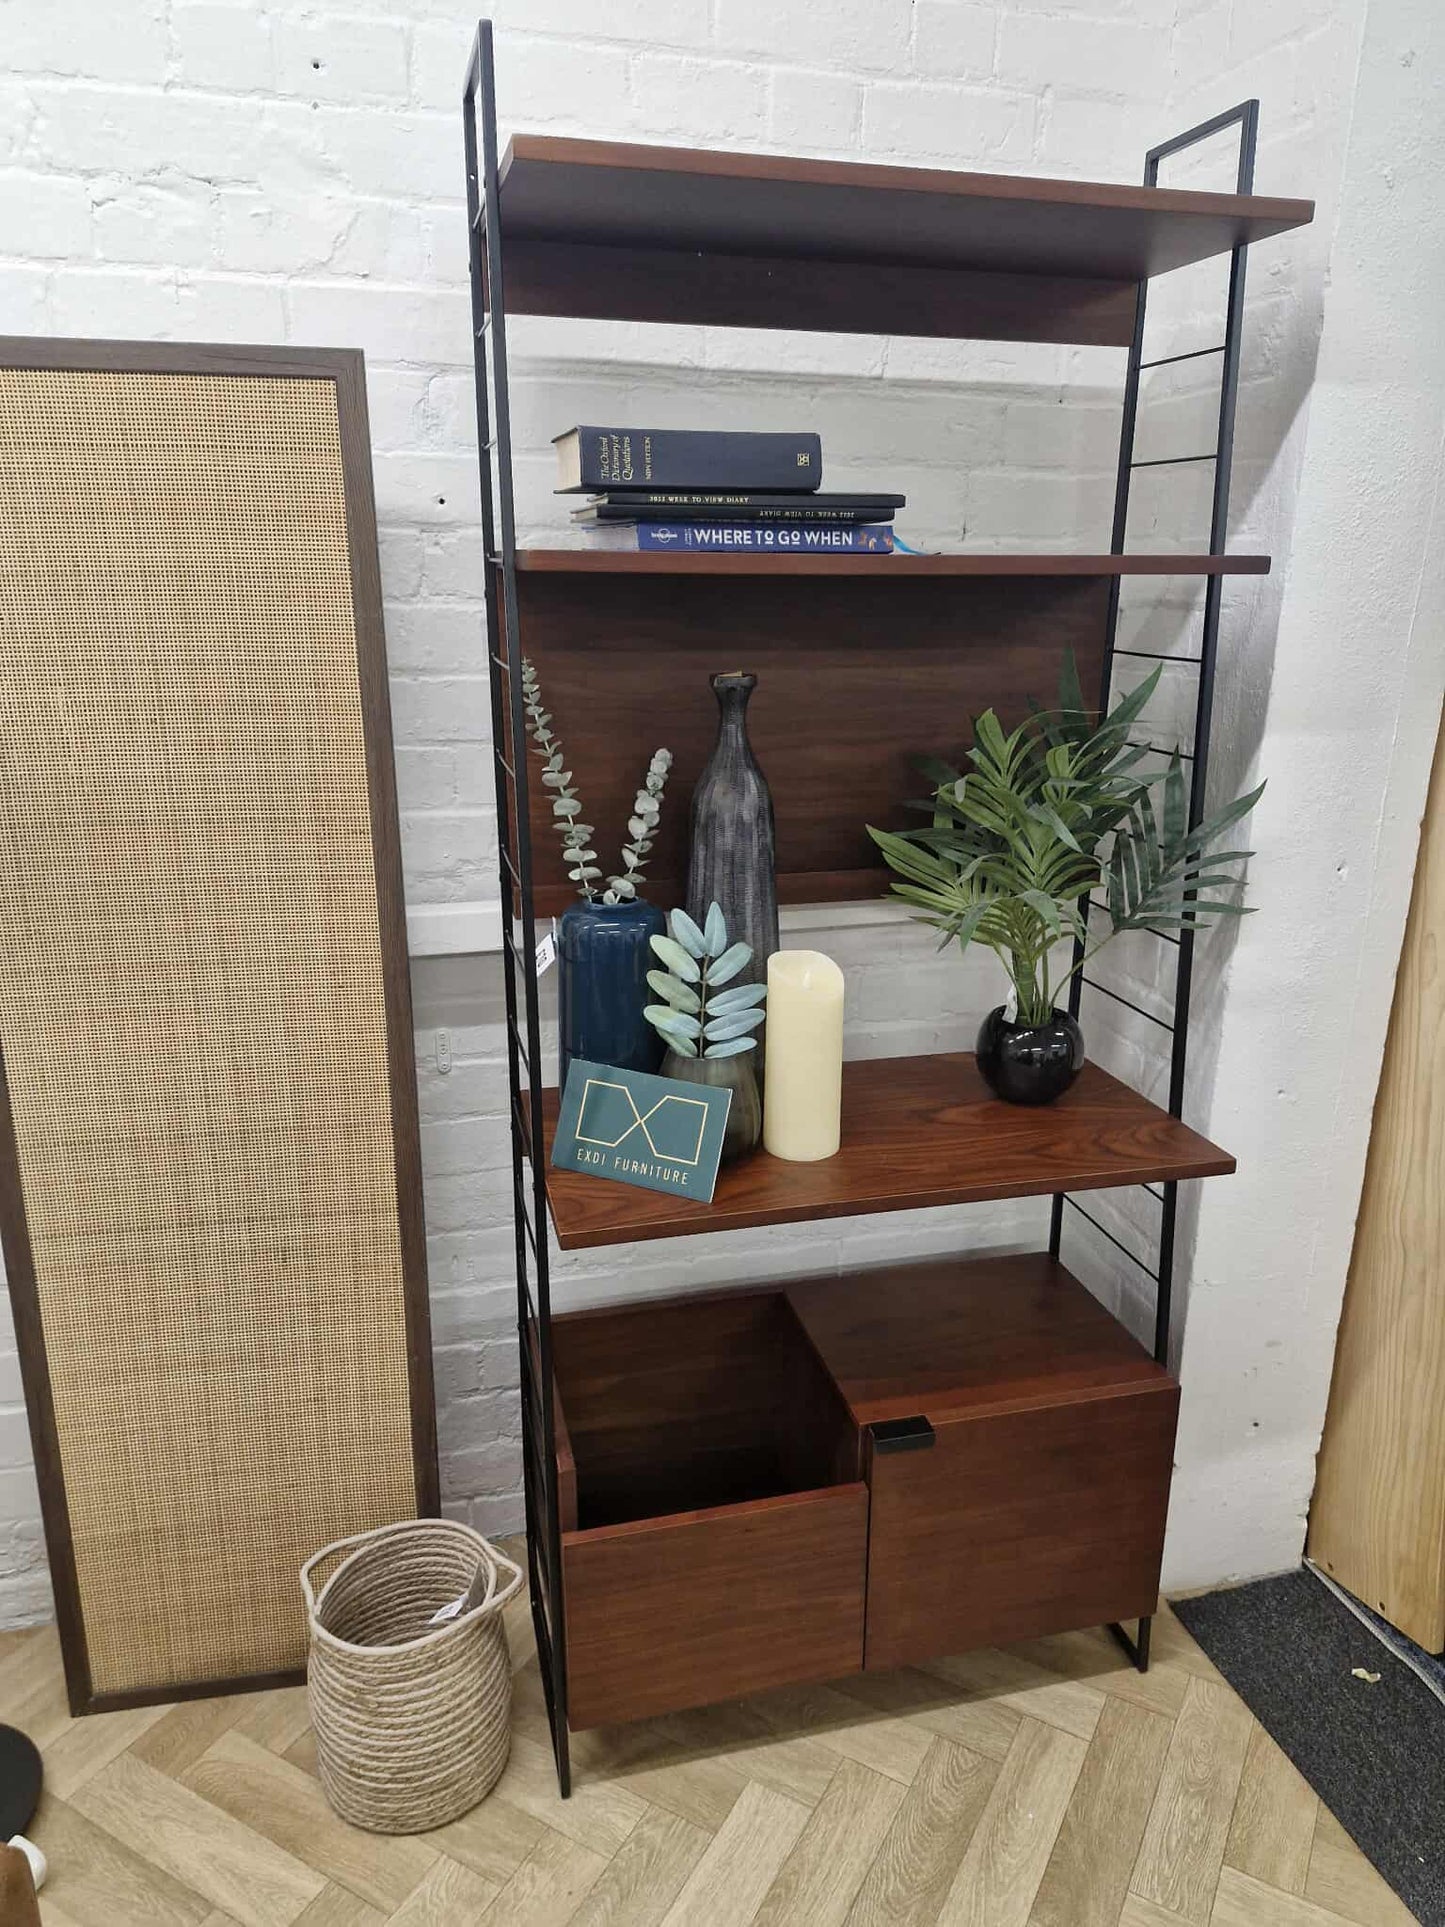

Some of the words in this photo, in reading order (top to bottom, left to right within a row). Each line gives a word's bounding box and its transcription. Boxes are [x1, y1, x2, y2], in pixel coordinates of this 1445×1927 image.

[599, 436, 610, 463] Oxford
[611, 443, 621, 481] Dictionary
[622, 436, 634, 481] Quotations
[601, 463, 610, 479] The
[704, 496, 724, 504] VIEW
[726, 496, 750, 504] DIARY
[694, 528, 753, 545] WHERE
[754, 530, 774, 545] TO
[777, 530, 801, 545] GO
[804, 531, 853, 546] WHEN
[576, 1148, 606, 1166] EXDI
[614, 1156, 689, 1185] FURNITURE
